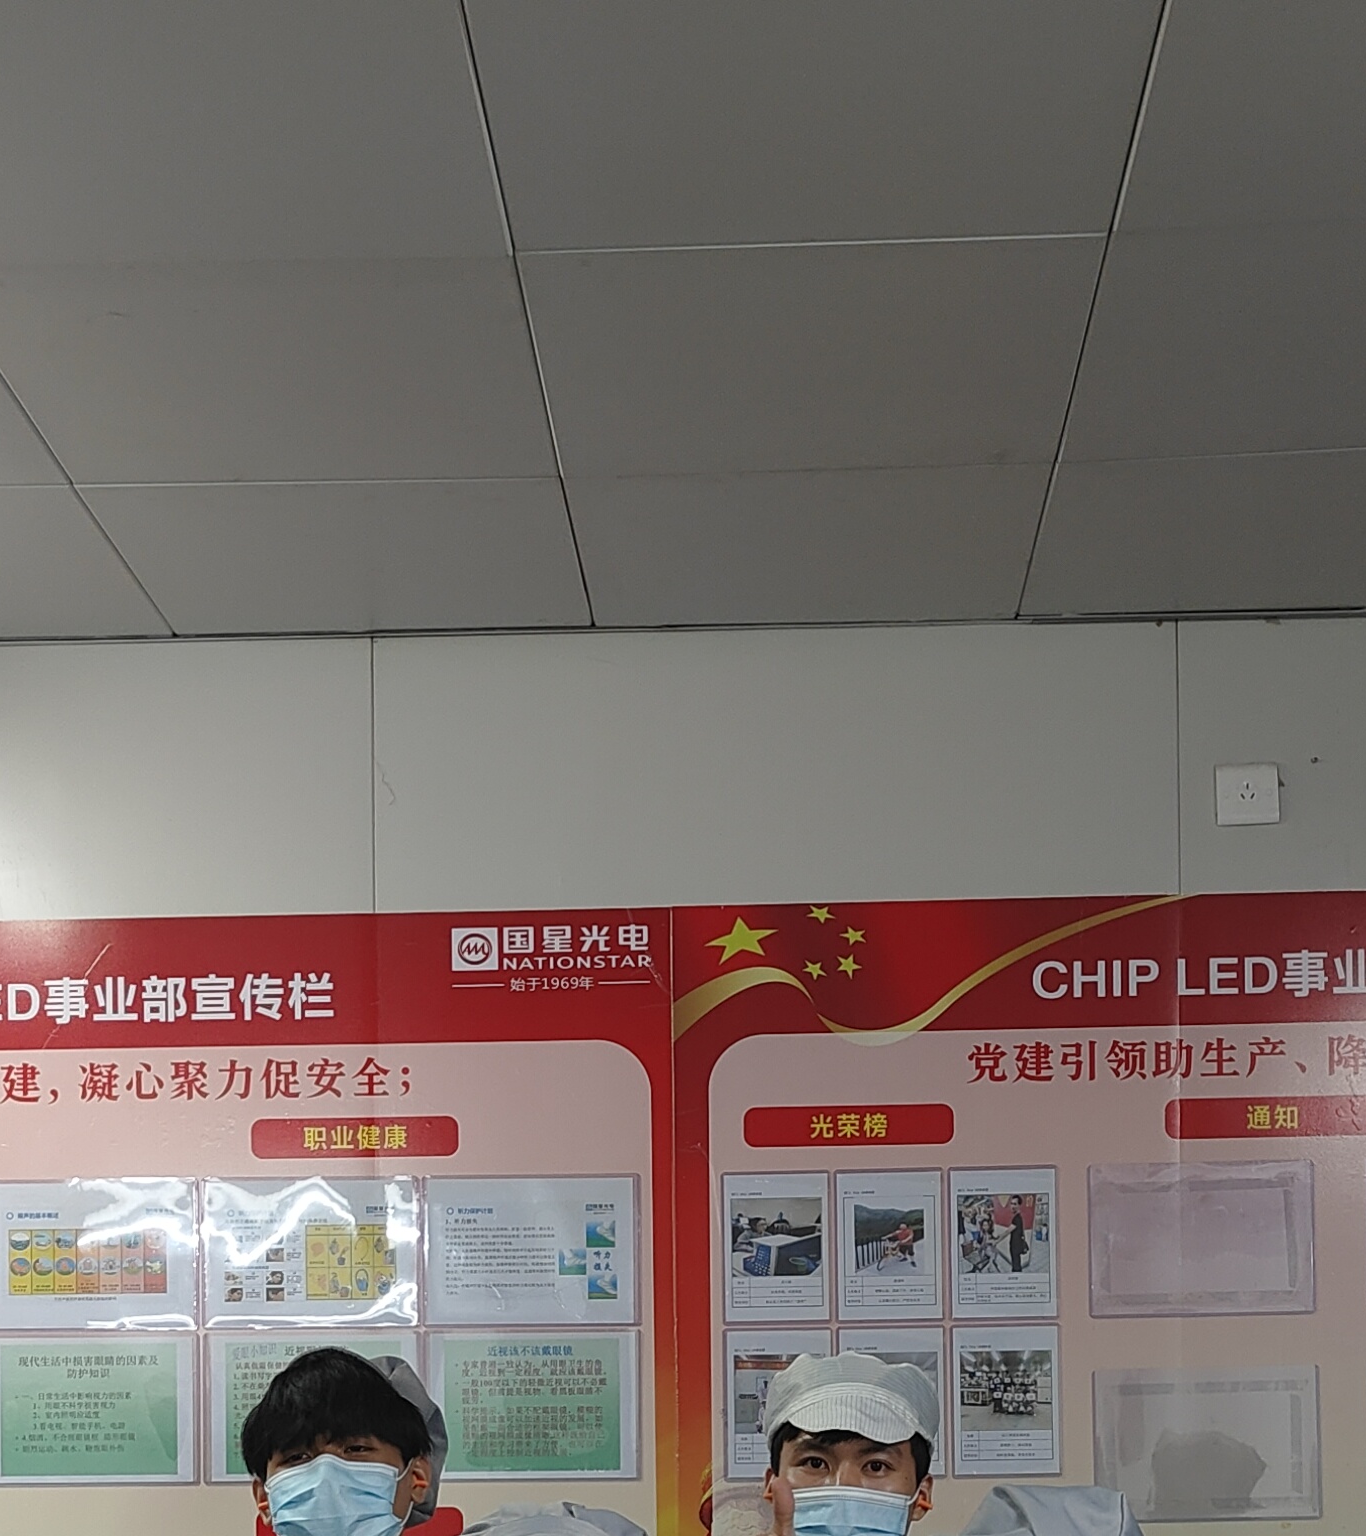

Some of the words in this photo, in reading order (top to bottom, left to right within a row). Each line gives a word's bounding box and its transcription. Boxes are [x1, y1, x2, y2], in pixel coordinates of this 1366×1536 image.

[502, 923, 650, 953] 国星光电
[502, 955, 651, 970] NATIONSTAR
[508, 976, 594, 992] 始于1969年
[1031, 958, 1159, 1000] CHIP
[810, 1113, 889, 1140] 光荣榜
[1246, 1105, 1299, 1131] 通知
[303, 1124, 407, 1151] 职业健康
[17, 1355, 159, 1368] 现代生活中损害眼睛的因素及
[487, 1345, 574, 1357] 近视该不该戴眼镜
[66, 1368, 111, 1380] 防护知识
